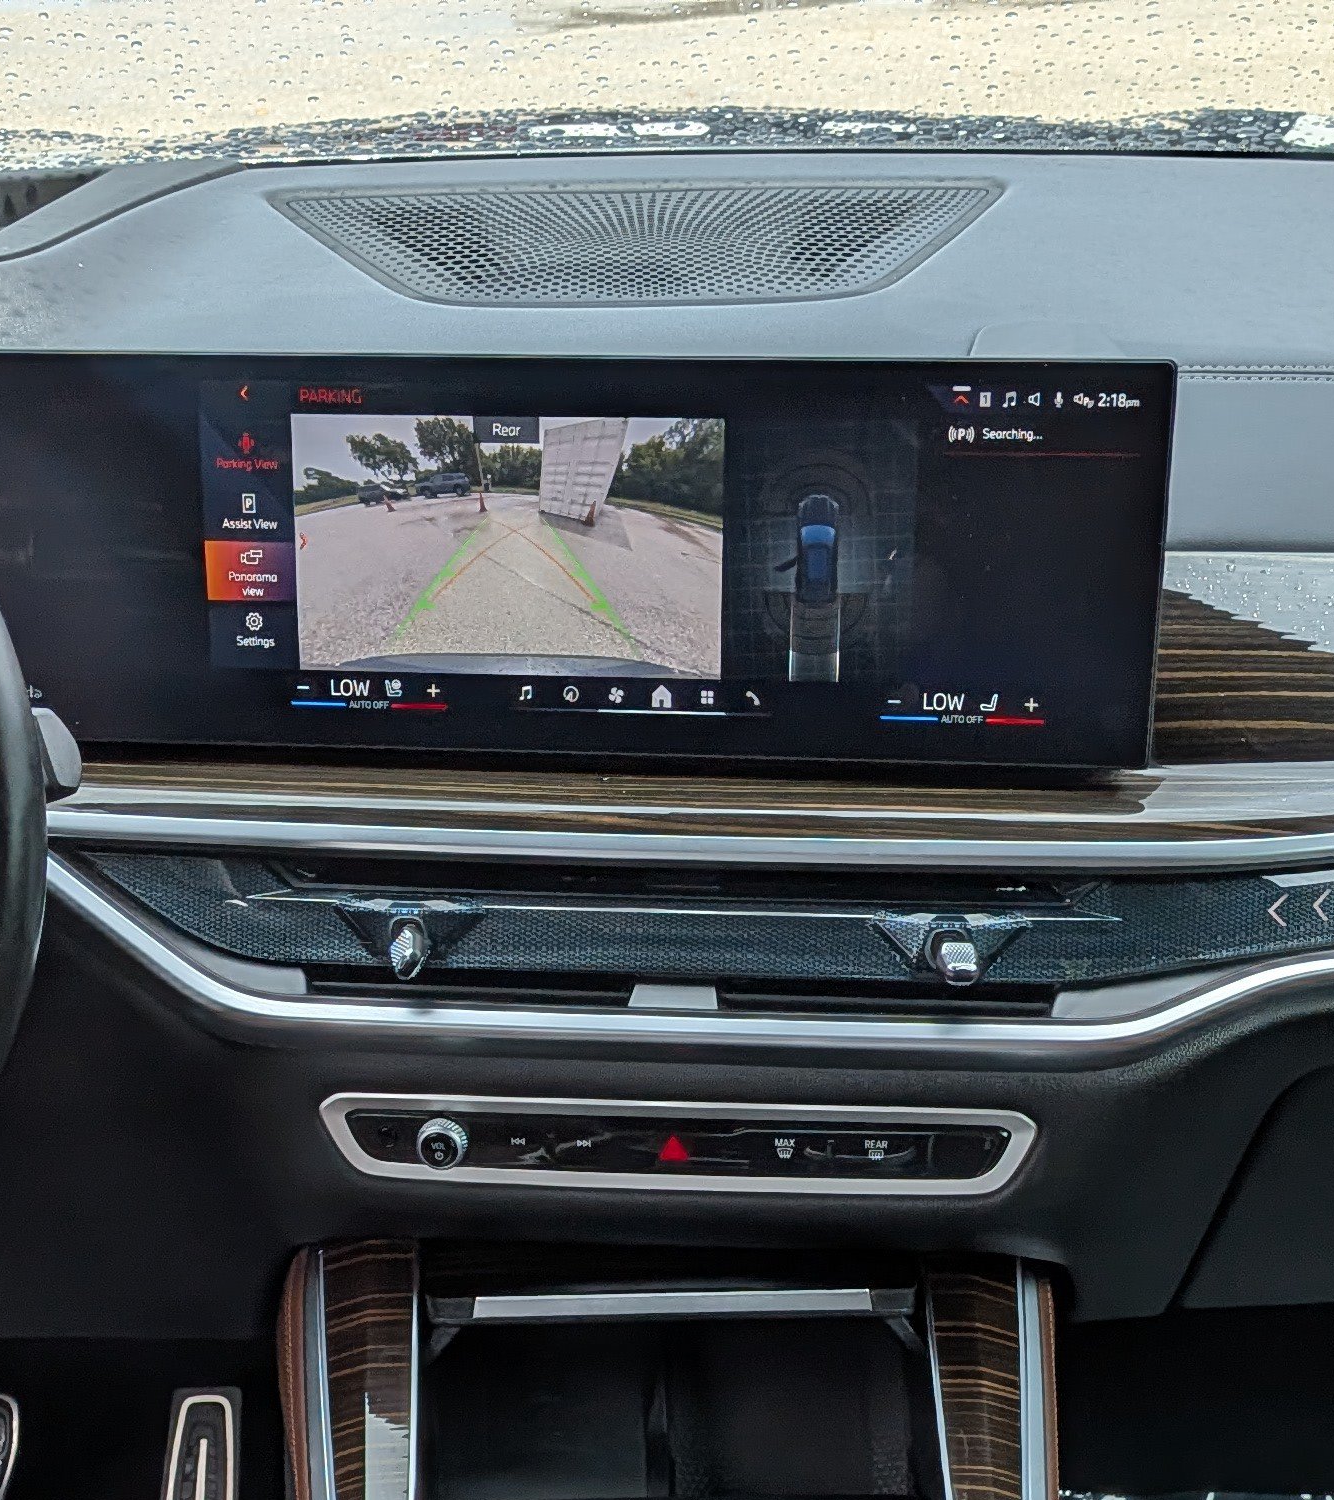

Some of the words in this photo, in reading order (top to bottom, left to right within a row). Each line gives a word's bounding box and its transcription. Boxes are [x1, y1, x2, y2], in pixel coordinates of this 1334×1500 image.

[299, 388, 361, 403] PARKING
[1097, 393, 1140, 408] 2:18pm
[492, 423, 521, 437] Rear
[982, 428, 1043, 442] Searching...
[216, 457, 252, 471] Parking
[255, 458, 278, 470] View
[222, 518, 249, 530] Assist
[251, 518, 278, 530] View
[228, 571, 278, 583] Panorama
[242, 586, 265, 597] view
[236, 635, 275, 649] Settings
[330, 679, 370, 697] LOW
[348, 700, 371, 709] AUTO
[372, 701, 390, 710] OFF
[923, 692, 965, 711] LOW
[940, 715, 965, 724] AUTO
[966, 716, 984, 724] OFF
[774, 1138, 795, 1147] MAX
[864, 1139, 888, 1149] REAR
